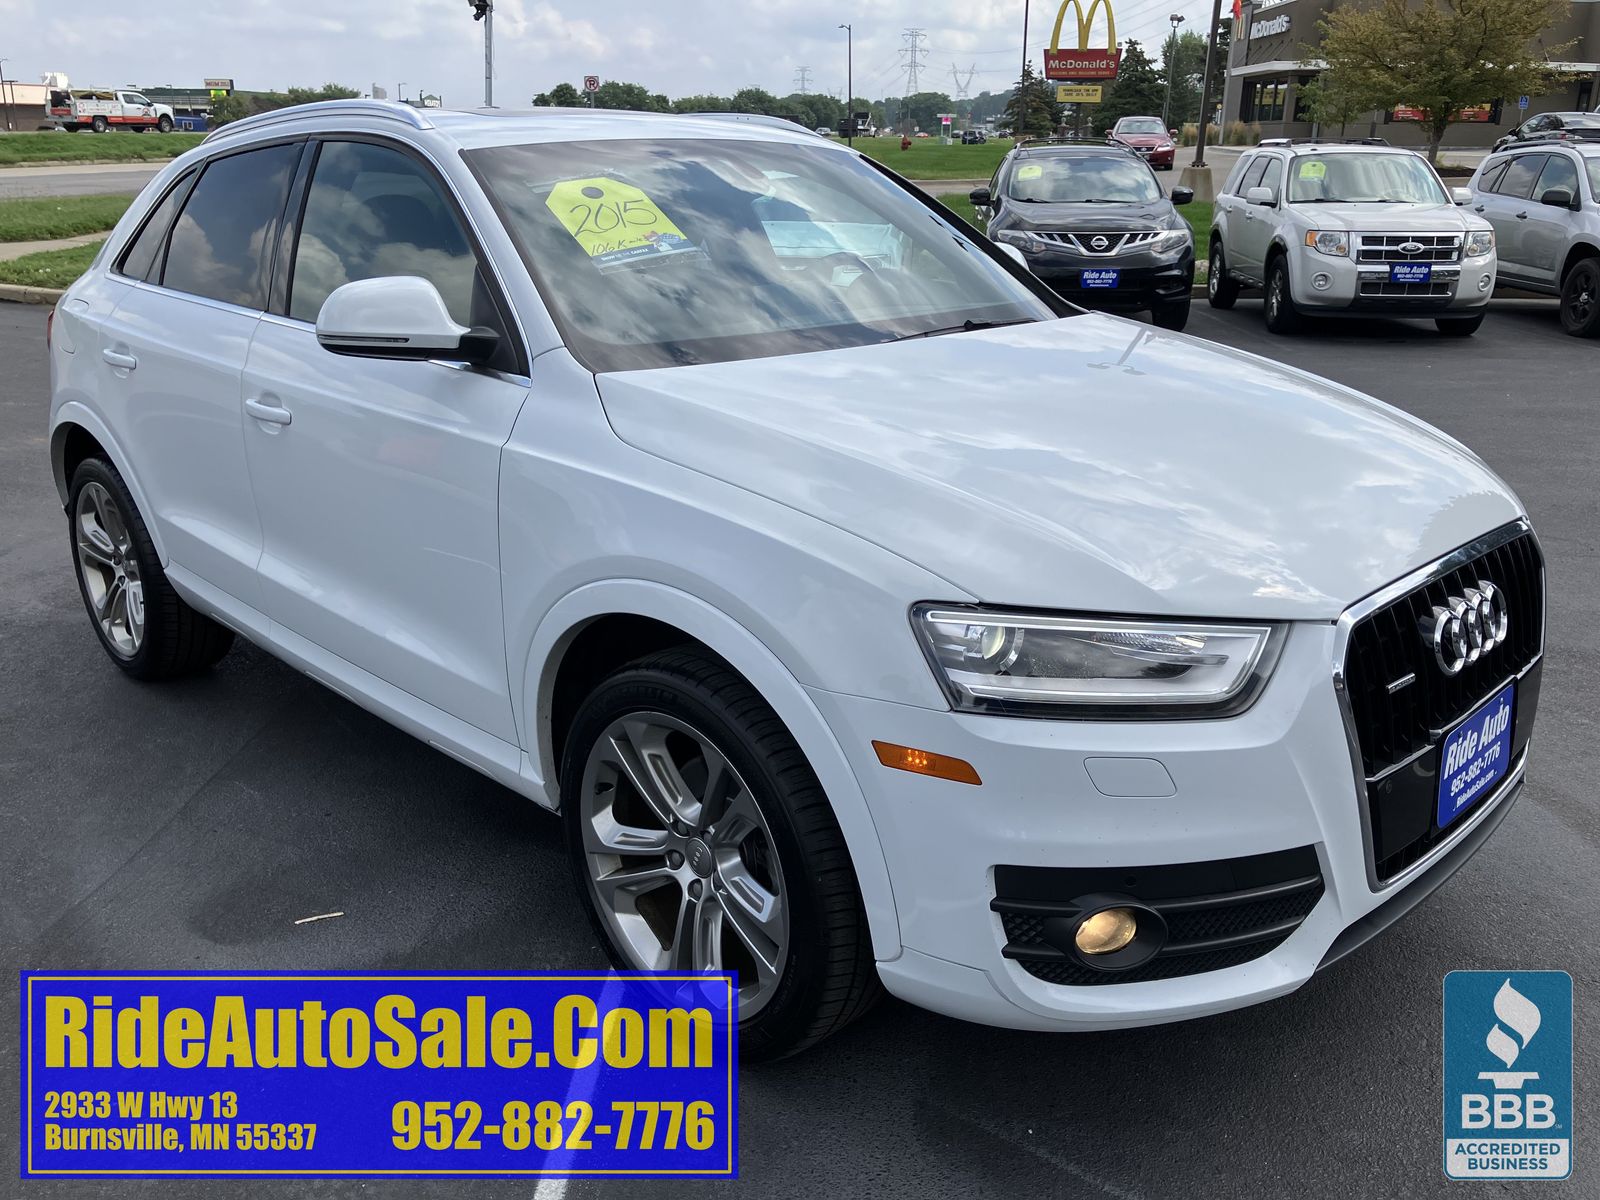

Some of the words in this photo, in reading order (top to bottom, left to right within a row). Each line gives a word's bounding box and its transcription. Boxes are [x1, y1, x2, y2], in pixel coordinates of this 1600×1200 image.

[1048, 60, 1115, 69] McDonald's
[569, 199, 658, 238] 2015
[1083, 271, 1100, 279] Ride
[1100, 271, 1117, 279] Auto
[1394, 265, 1411, 273] Ride
[1411, 265, 1429, 273] Auto
[1444, 730, 1478, 780] Ride
[1478, 703, 1510, 752] Auto
[1450, 741, 1501, 797] 952-882-7776
